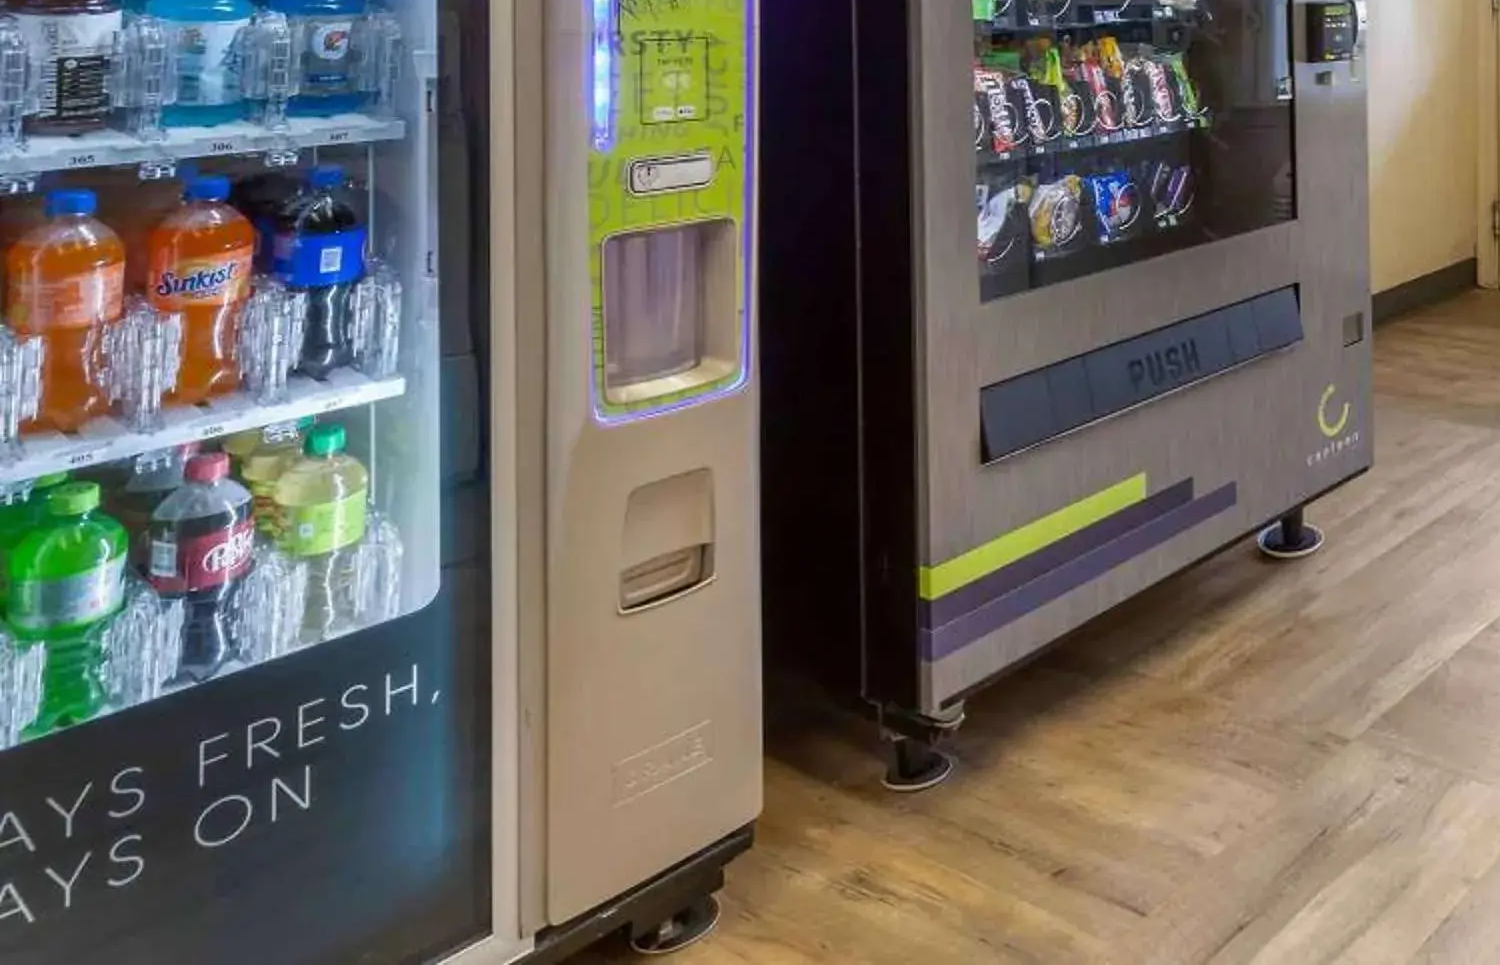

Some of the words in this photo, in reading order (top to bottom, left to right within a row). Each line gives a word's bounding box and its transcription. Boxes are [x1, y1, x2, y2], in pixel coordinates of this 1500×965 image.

[156, 261, 237, 296] Sunkist
[1127, 338, 1201, 393] PUSH
[198, 663, 443, 788] FRESH,
[193, 764, 312, 847] ON
